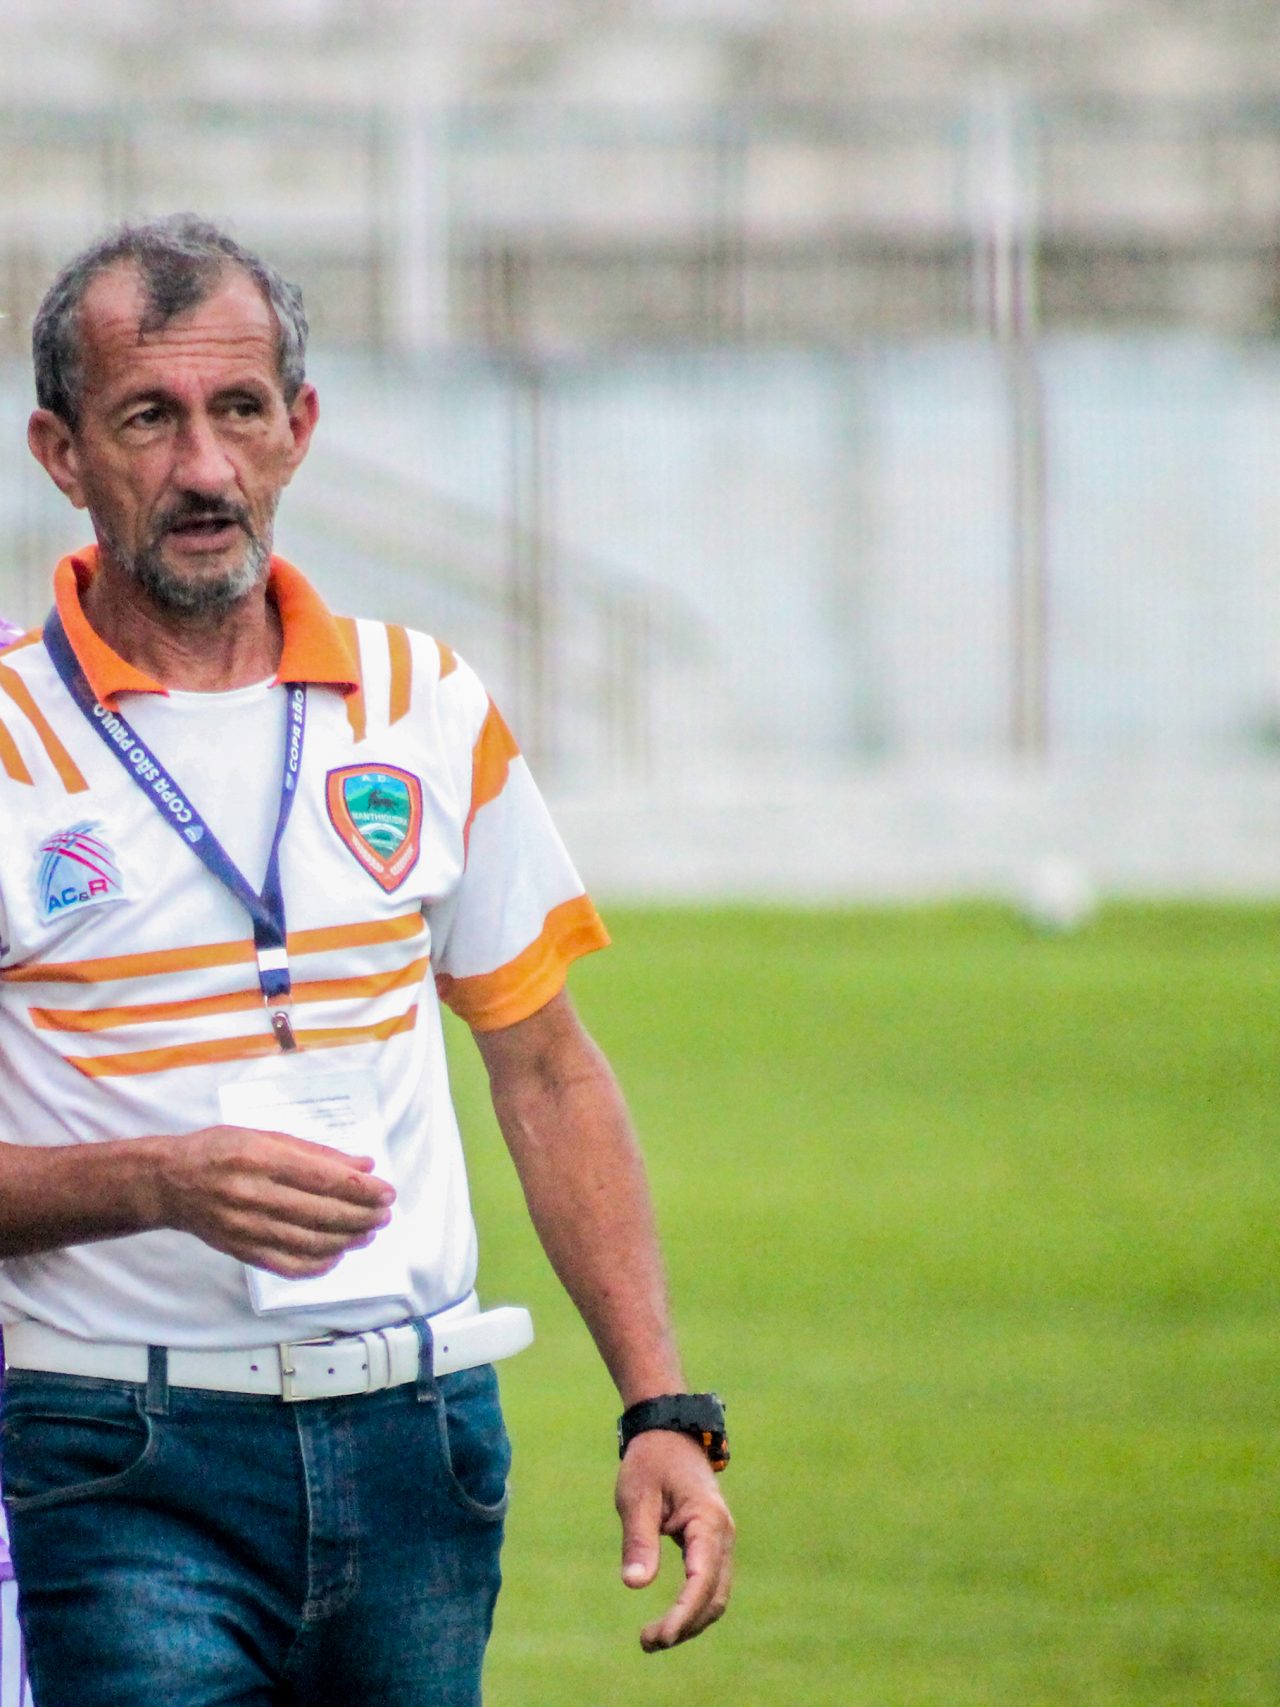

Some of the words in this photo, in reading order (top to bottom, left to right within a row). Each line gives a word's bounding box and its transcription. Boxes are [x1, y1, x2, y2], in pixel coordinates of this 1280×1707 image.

[128, 748, 160, 781] SÃO
[289, 725, 301, 773] COPA
[152, 778, 192, 823] COPA
